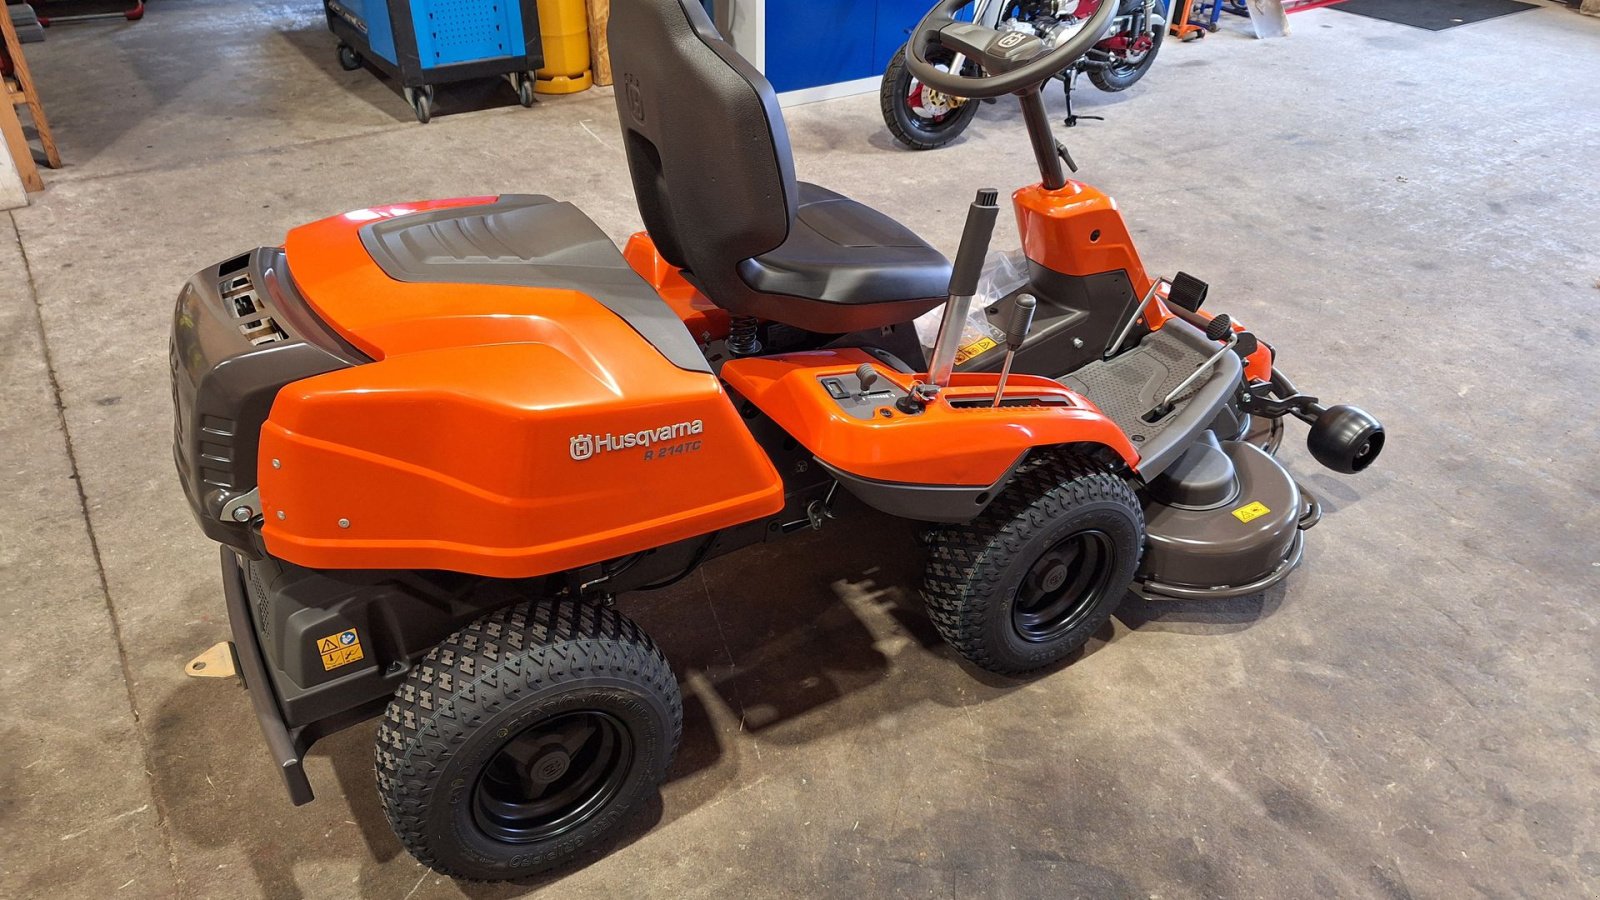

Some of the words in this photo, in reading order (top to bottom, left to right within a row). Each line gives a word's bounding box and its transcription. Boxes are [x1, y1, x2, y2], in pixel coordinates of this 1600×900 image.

[595, 418, 703, 454] Husqvarna
[643, 449, 653, 461] R
[658, 440, 703, 459] 214TC
